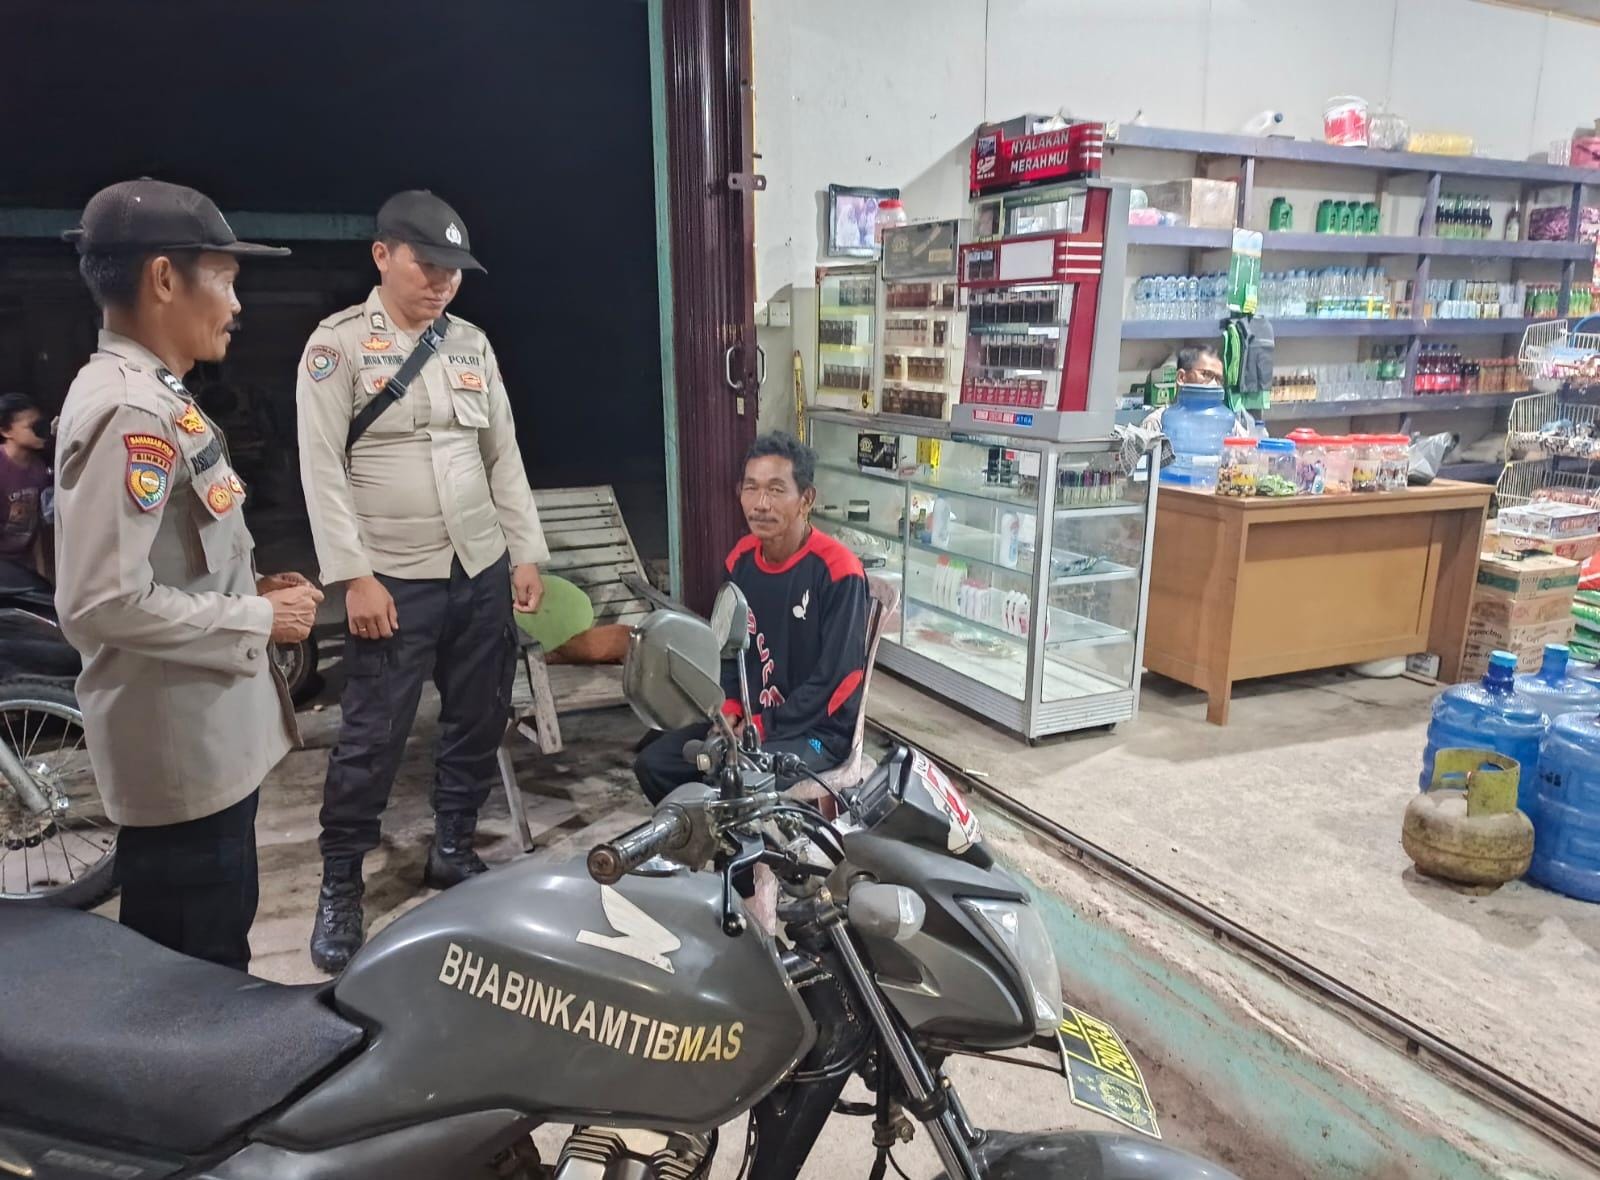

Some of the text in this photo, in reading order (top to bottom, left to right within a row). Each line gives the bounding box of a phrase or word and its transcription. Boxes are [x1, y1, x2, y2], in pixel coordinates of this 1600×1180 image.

[1011, 130, 1069, 155] NYALAKAN
[448, 355, 481, 366] POLRI
[438, 942, 744, 1063] BHABINKAMTIBMAS
